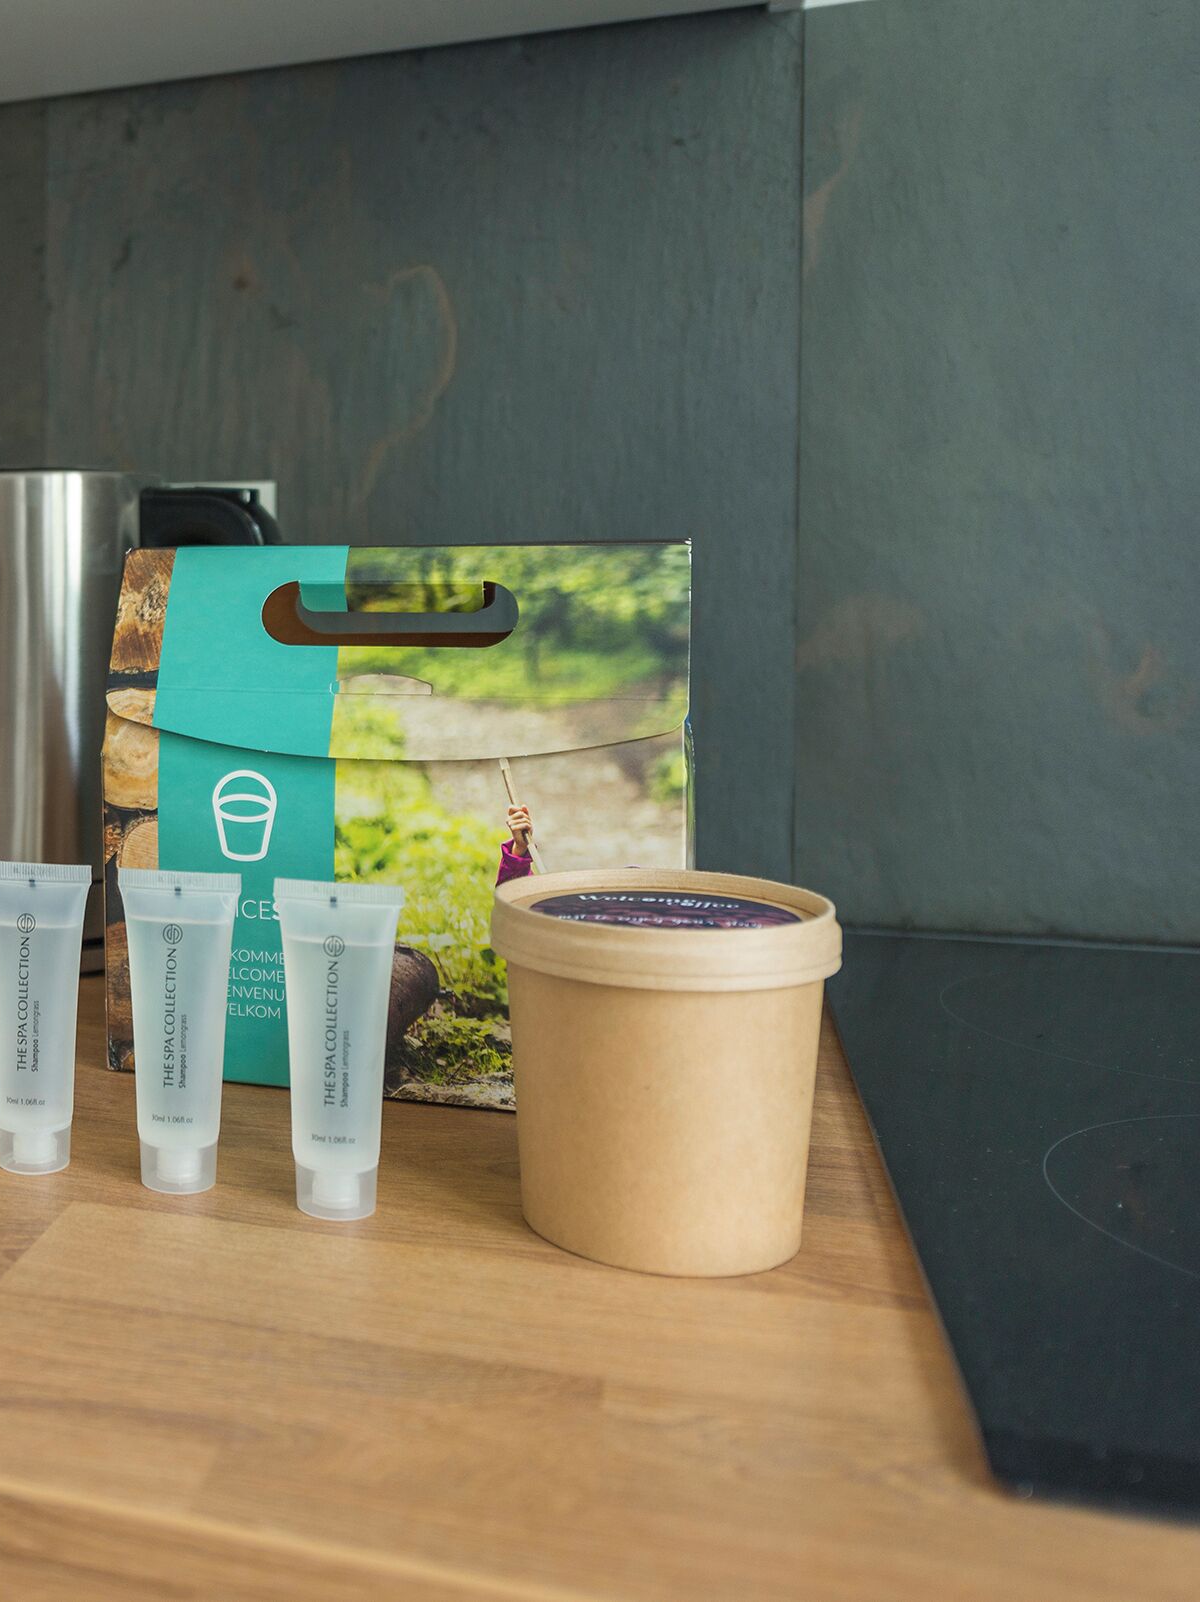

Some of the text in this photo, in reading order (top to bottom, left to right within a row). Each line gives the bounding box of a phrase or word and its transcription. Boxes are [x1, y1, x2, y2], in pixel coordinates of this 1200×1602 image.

[17, 937, 30, 1071] THE SPA COLLECTION
[31, 1000, 42, 1072] Shampoo Lemongrass
[163, 948, 177, 1088] THE SPA COLLECTION
[227, 1002, 281, 1019] ELKOM
[323, 960, 340, 1107] THE SPA COLLECTION
[179, 1014, 189, 1089] Shampoo Lemongrass
[340, 1072, 349, 1108] Shampoo
